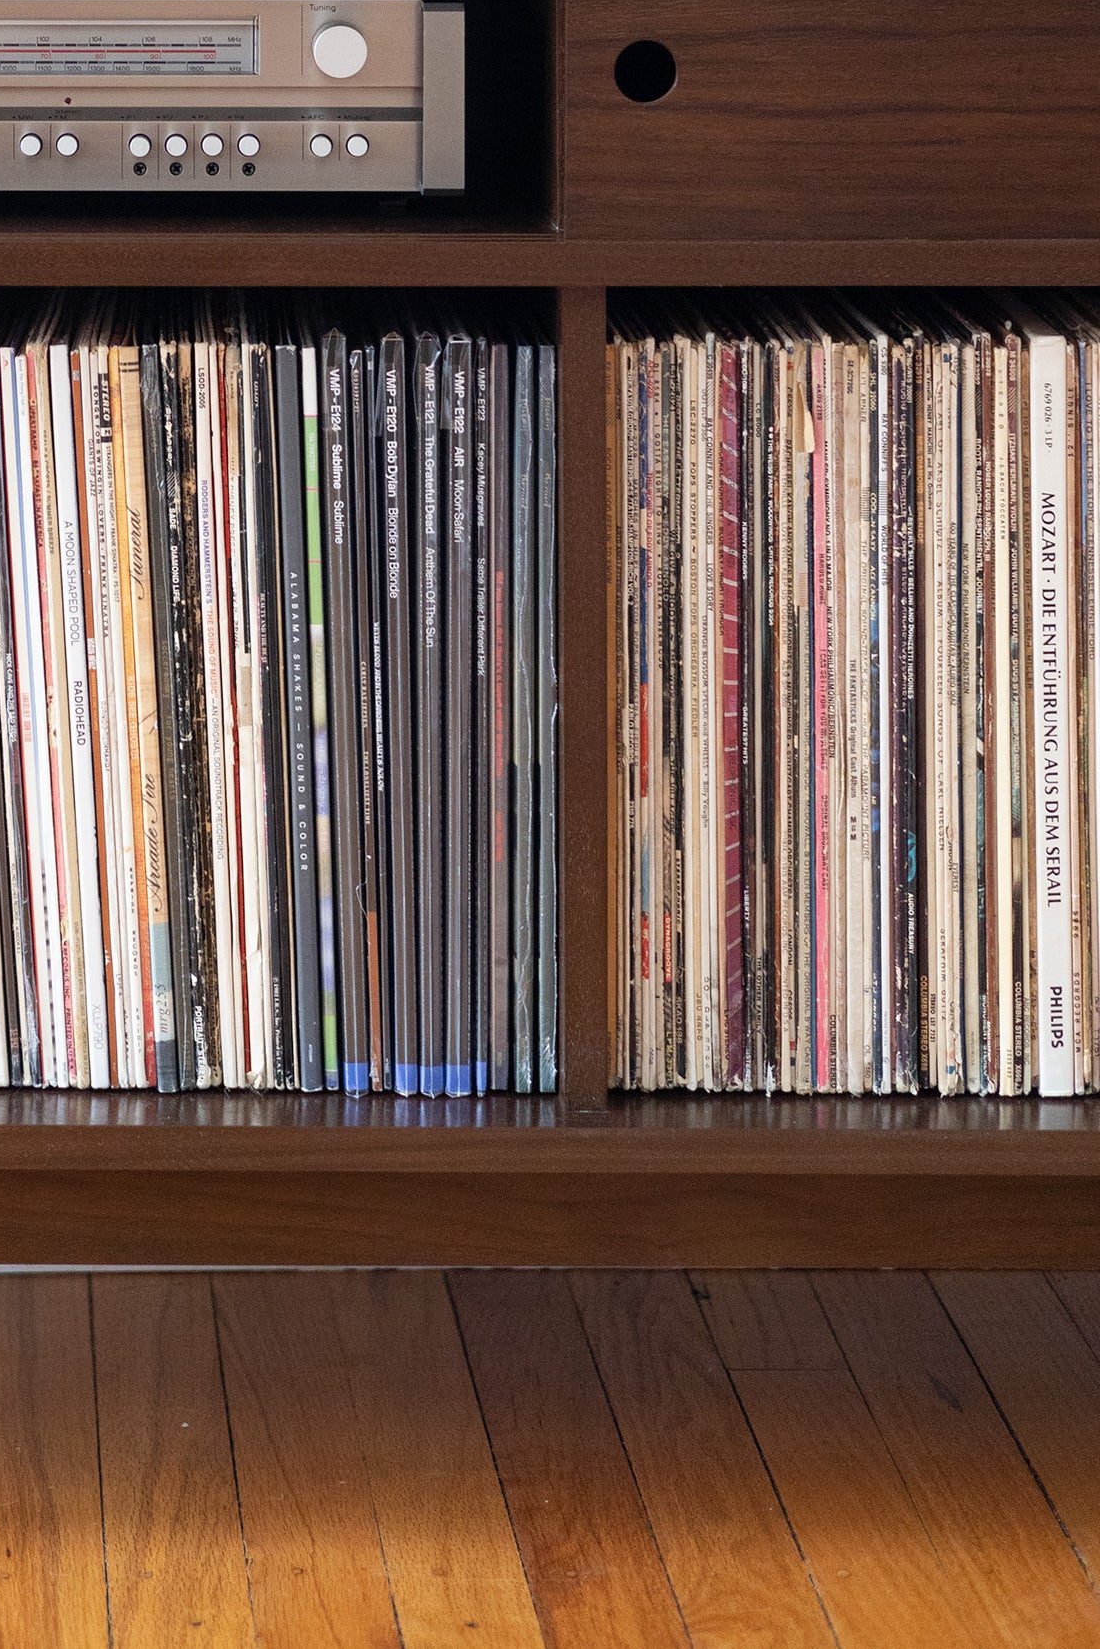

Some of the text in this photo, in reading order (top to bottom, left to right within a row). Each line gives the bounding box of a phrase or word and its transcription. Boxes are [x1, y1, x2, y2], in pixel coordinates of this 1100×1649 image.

[309, 4, 336, 12] Tuning
[329, 369, 345, 544] VMP E124 Sublime Sublime
[453, 372, 465, 542] VMP E122 AIR Moon Safari
[201, 480, 209, 518] RODGERS
[385, 370, 400, 598] VMP E120 Bob Dylan Blonde on Blonde
[424, 365, 436, 647] VMP E121 The Grateful Dead Anthem Of The Sun
[66, 532, 76, 566] MOON
[202, 520, 210, 537] AND
[68, 570, 78, 614] SHAPED
[202, 540, 213, 604] HAMMERSTEIN'S
[69, 617, 80, 646] POOL
[290, 572, 300, 643] ALABAMA
[207, 627, 216, 656] SOUND
[209, 658, 217, 668] OF
[962, 588, 970, 694] PHILHARMONIC/BERNSTEIN
[293, 654, 302, 712] SHAKES
[73, 681, 86, 745] RADIOHEAD
[296, 743, 305, 793] SOUND
[1041, 492, 1064, 1048] MOZART DIE ENTFÜHRUNG AUS DEM SERAIL PHILIPS
[298, 822, 308, 871] COLOR
[907, 893, 915, 954] AUDIO TREASURY
[91, 1004, 104, 1050] XLLP790
